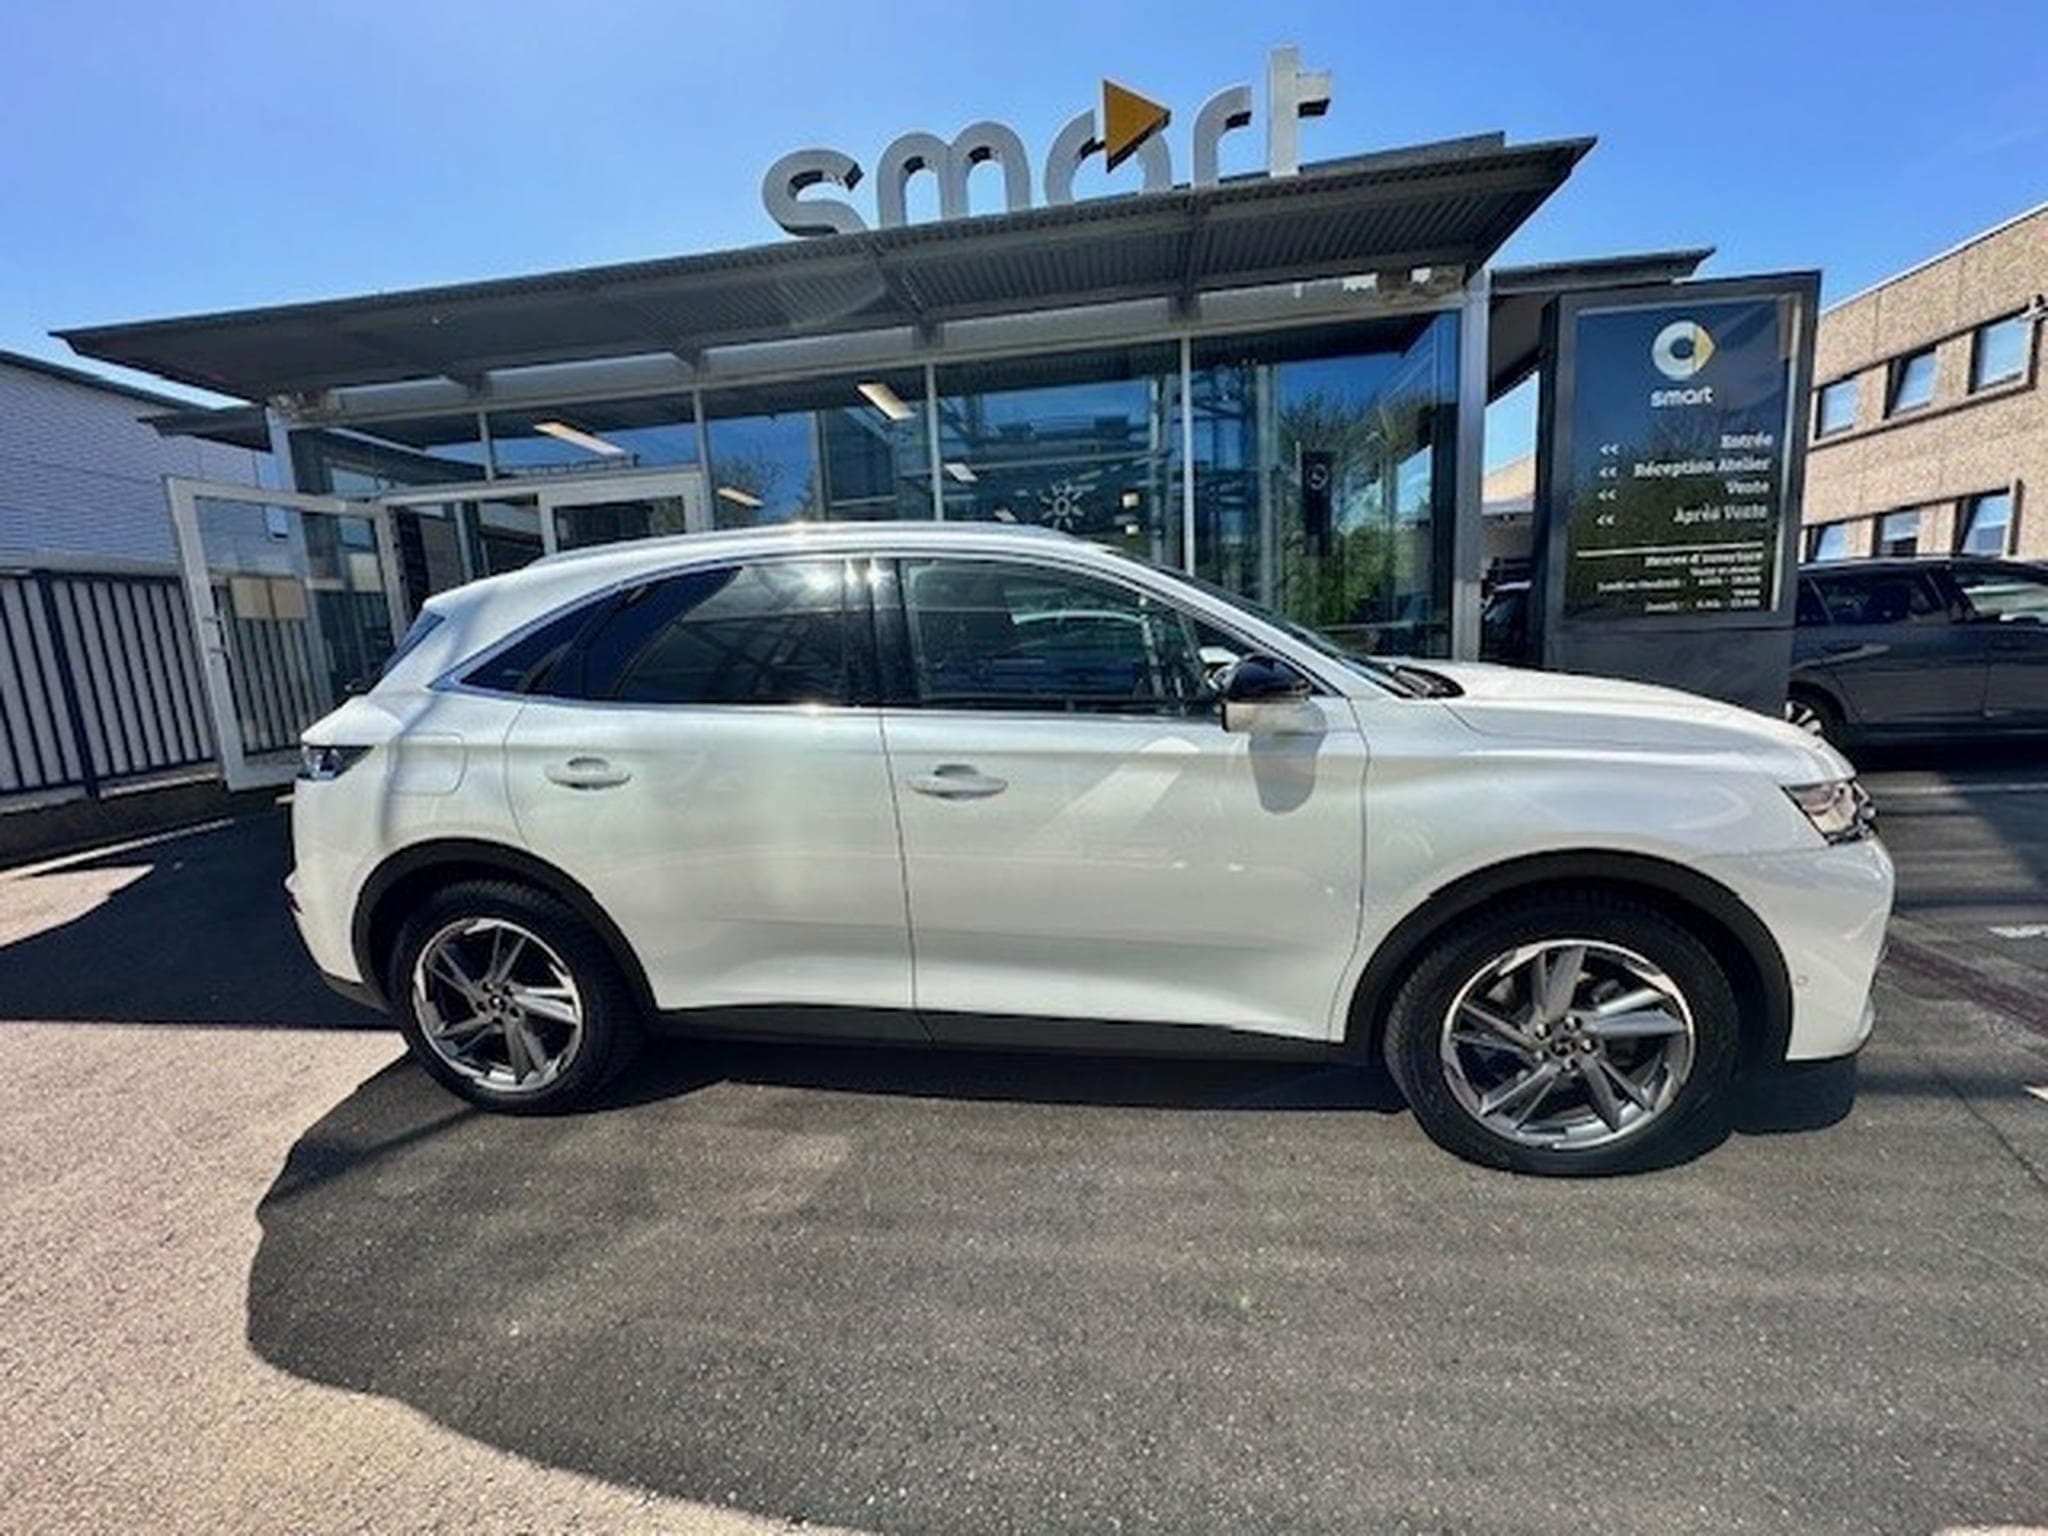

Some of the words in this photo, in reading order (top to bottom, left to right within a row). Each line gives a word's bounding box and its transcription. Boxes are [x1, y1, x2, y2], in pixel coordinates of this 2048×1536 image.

[761, 46, 1331, 237] smart
[1651, 386, 1713, 407] smart
[1720, 432, 1774, 449] Entrée
[1633, 460, 1716, 478] Réception
[1718, 457, 1772, 472] Atelier
[1726, 481, 1771, 495] Vente
[1723, 503, 1768, 519] Vente
